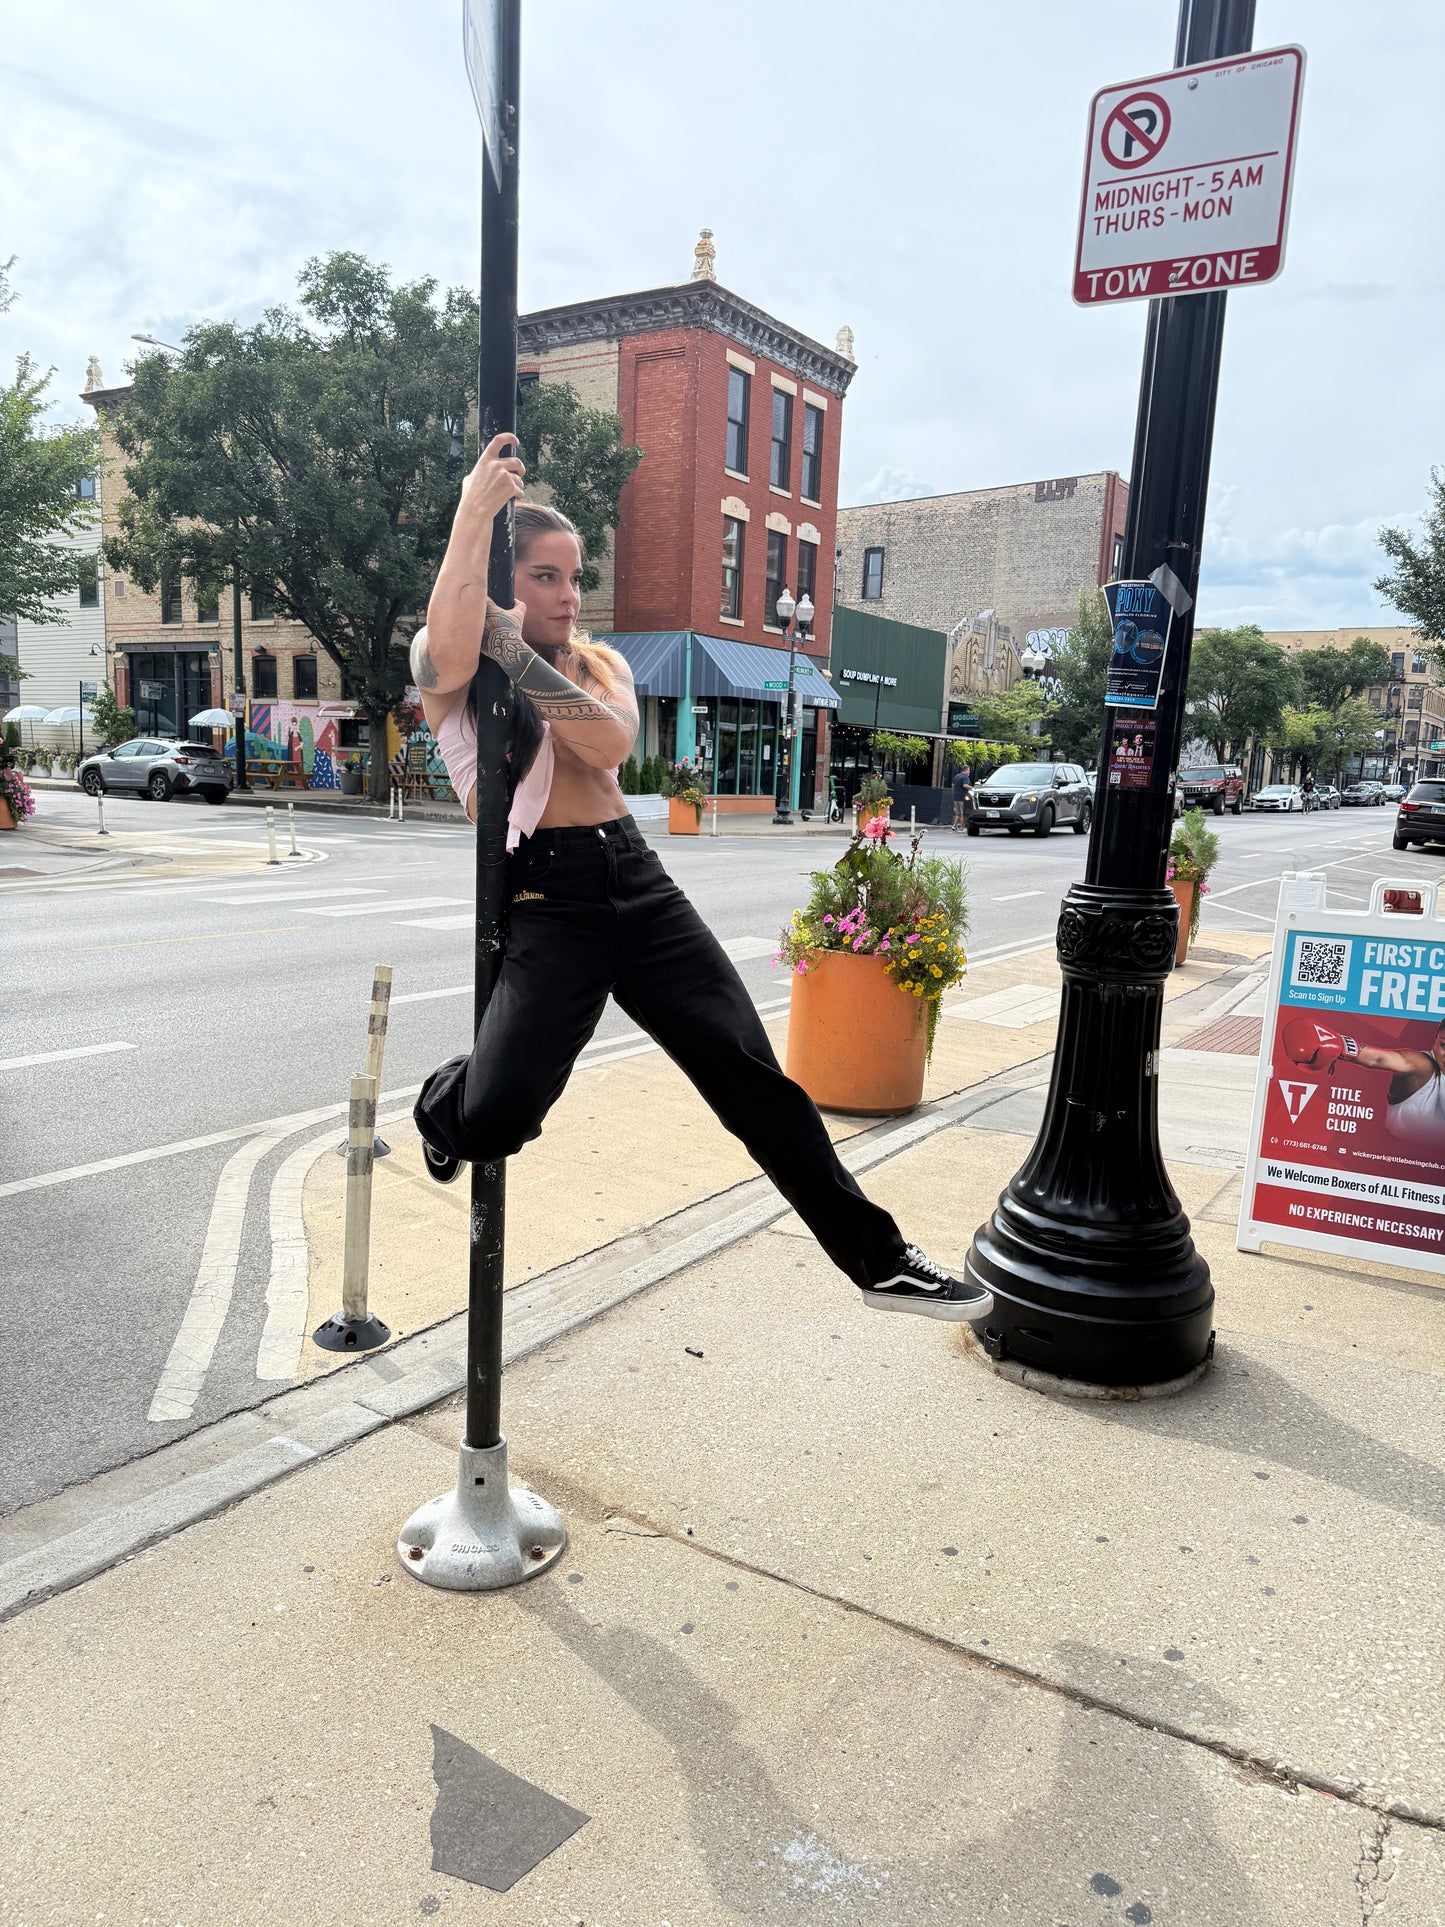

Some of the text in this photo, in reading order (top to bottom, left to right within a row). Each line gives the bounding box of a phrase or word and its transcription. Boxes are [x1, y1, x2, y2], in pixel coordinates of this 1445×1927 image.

[1215, 58, 1284, 78] CITY OF CHICAGO
[1087, 251, 1259, 298] TOW ZONE
[843, 669, 856, 679] SOUP
[884, 676, 897, 687] MORE
[1364, 942, 1426, 968] FIRST
[1289, 989, 1346, 1005] Scan to Sign Up
[1359, 969, 1445, 1014] FREE
[1330, 1086, 1362, 1102] TITLE
[1327, 1102, 1374, 1120] BOXING
[1326, 1117, 1357, 1133] CLUB
[1283, 1139, 1299, 1148] (773)
[1352, 1150, 1445, 1170] wickerpark@titleboxingclub.c
[1267, 1165, 1283, 1178] We
[1284, 1168, 1330, 1186] Welcome
[1331, 1176, 1366, 1193] Boxers
[1368, 1183, 1380, 1194] of
[1380, 1184, 1399, 1198] ALL
[1401, 1187, 1440, 1205] Fitness
[1289, 1203, 1444, 1242] NO EXPERIENCE NECESSARY
